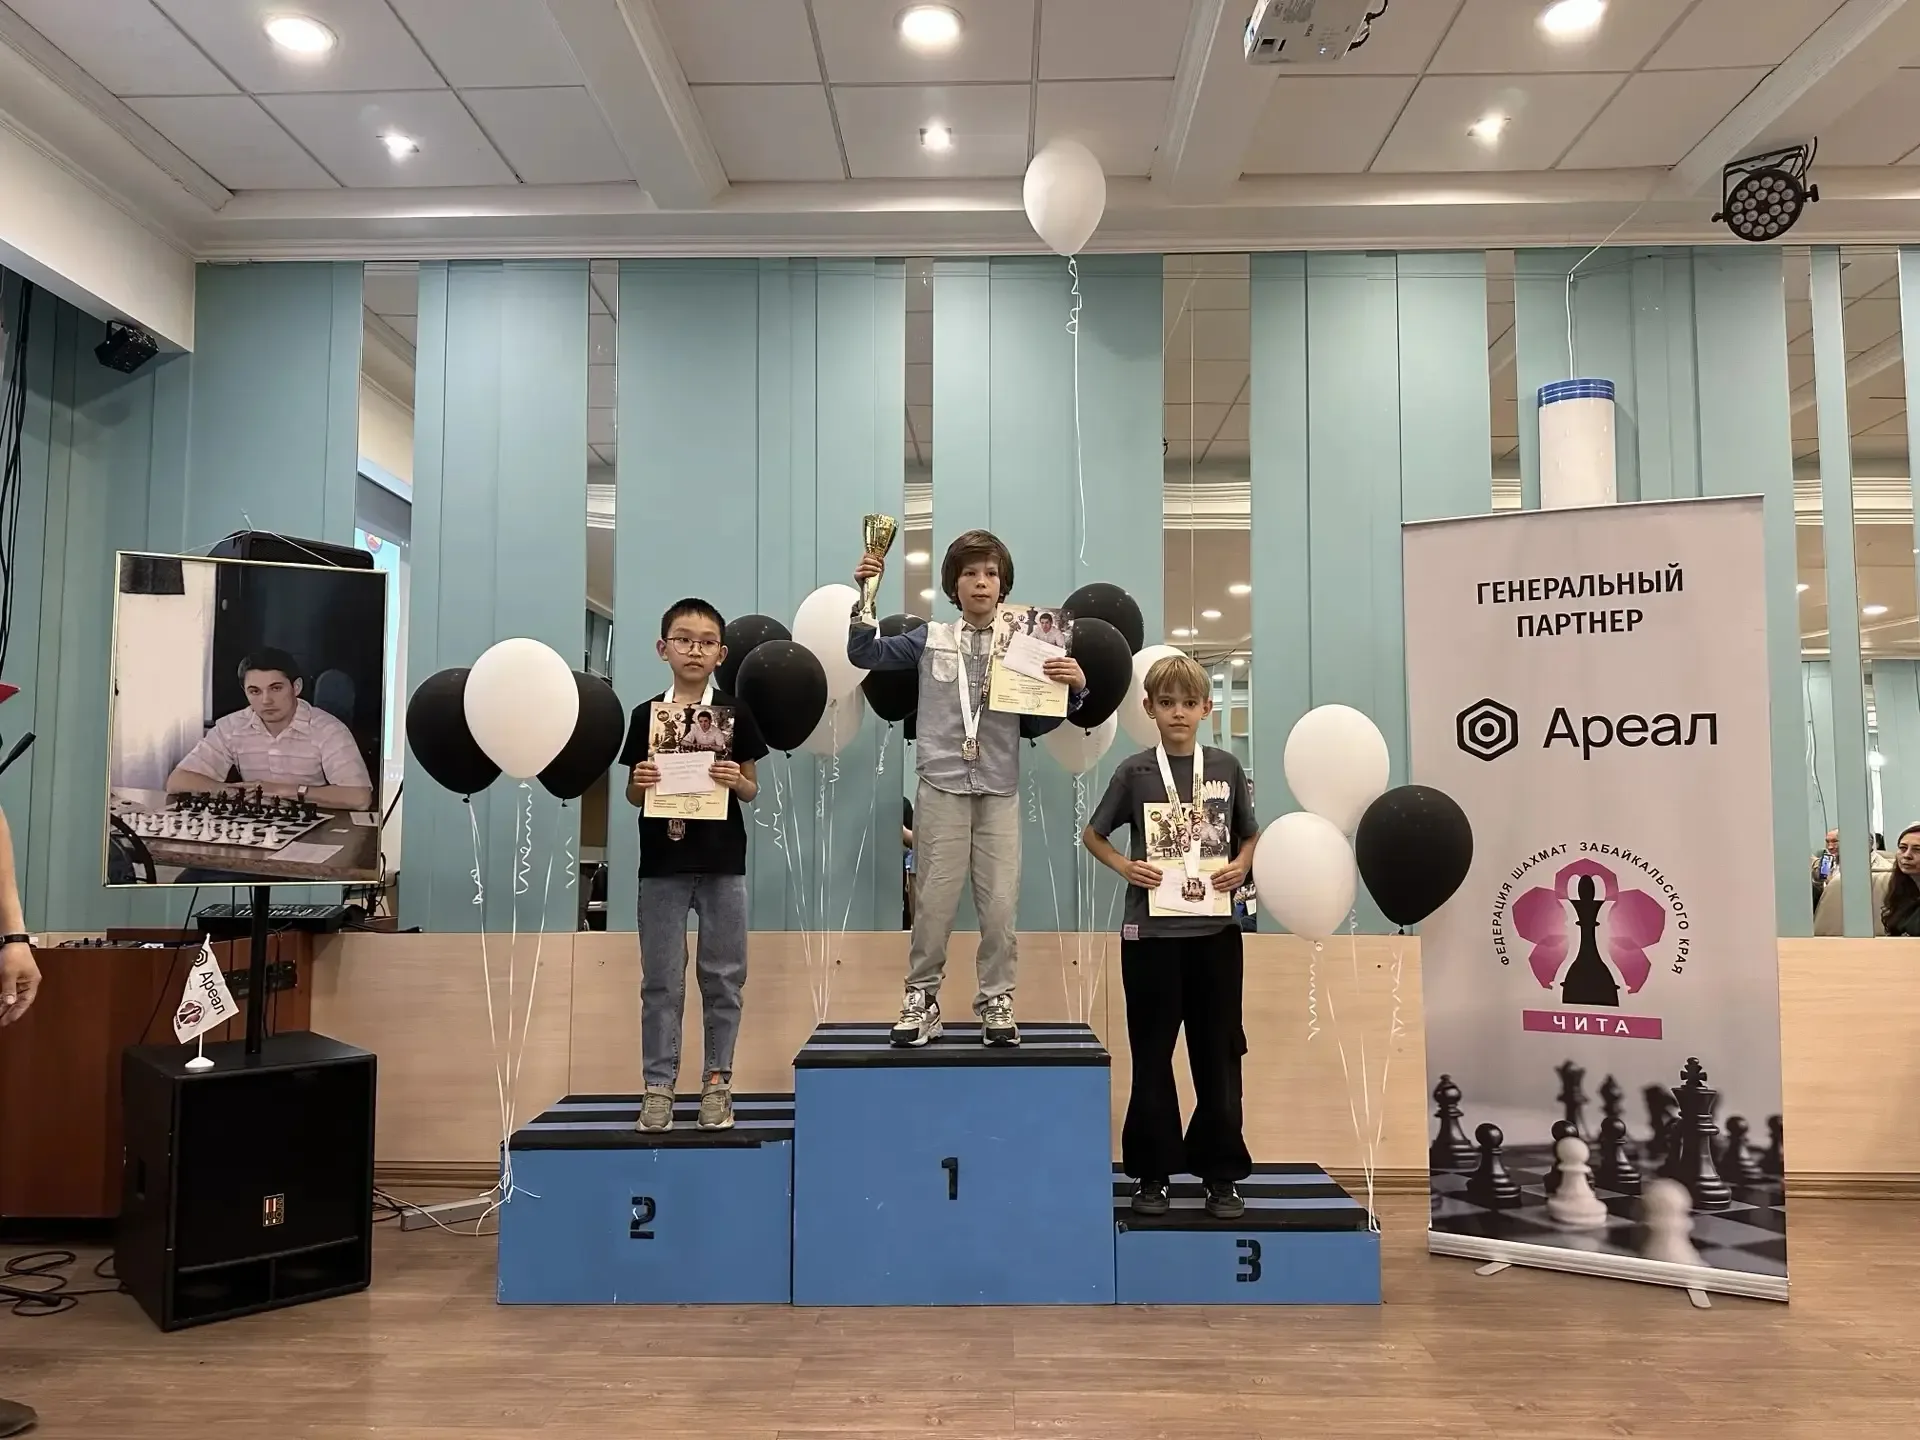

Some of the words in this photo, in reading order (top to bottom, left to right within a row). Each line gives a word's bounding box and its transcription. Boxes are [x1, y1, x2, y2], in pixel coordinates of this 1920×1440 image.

[1476, 562, 1684, 605] ГЕНЕРАЛЬНЫЙ
[1516, 608, 1644, 638] ПАРТНЕР
[1543, 707, 1718, 760] Ареал
[1492, 882, 1513, 966] ФЕДЕРАЦИЯ
[1511, 843, 1568, 880] ШАХМАТ
[1579, 842, 1689, 930] ЗАБАЙКАЛЬСКОГО
[1671, 938, 1690, 975] КРАЯ
[199, 971, 226, 1015] Ареал
[1553, 1015, 1630, 1034] ЧИТА
[942, 1157, 958, 1200] 1
[630, 1196, 656, 1239] 2
[1236, 1239, 1261, 1282] 3
